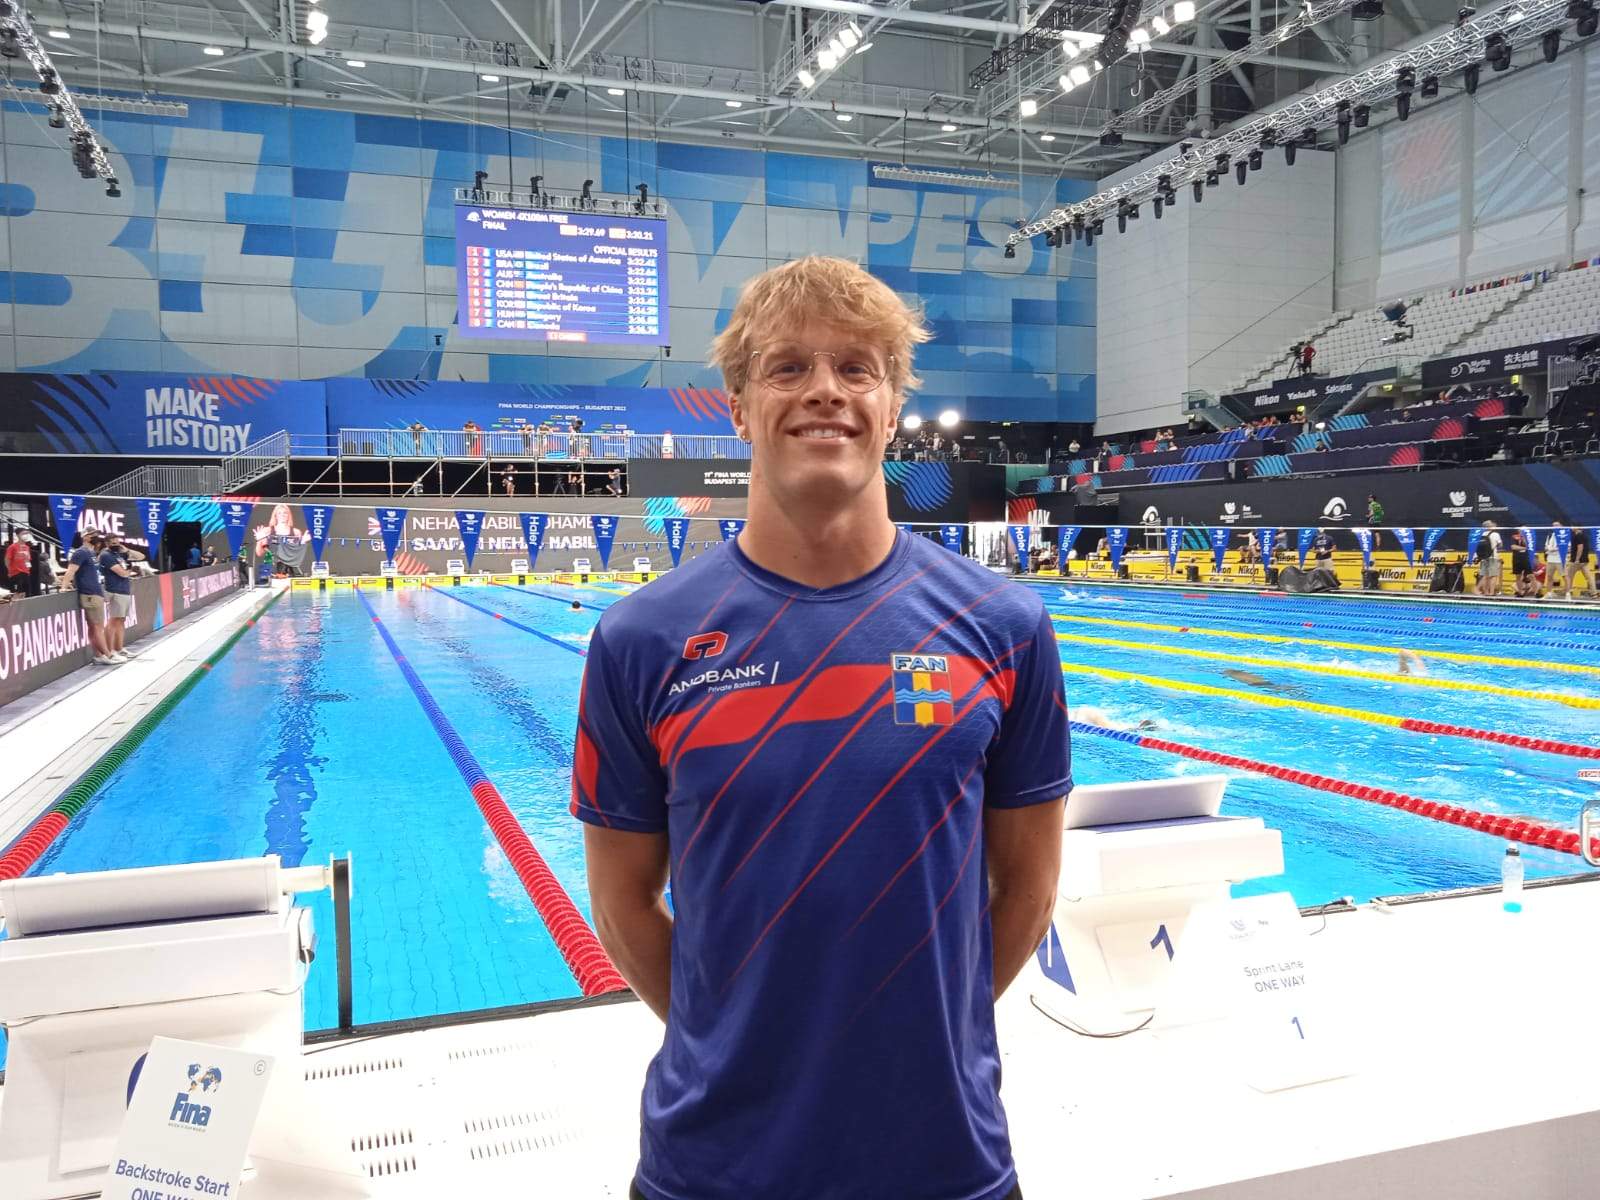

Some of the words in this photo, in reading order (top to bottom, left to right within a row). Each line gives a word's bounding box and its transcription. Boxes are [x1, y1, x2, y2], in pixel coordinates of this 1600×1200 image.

[482, 210, 516, 220] WOMEN
[482, 221, 507, 230] FINAL
[594, 246, 627, 255] OFFICIAL
[628, 248, 657, 257] RESULTS
[145, 387, 220, 421] MAKE
[1254, 394, 1280, 406] Nikon
[146, 418, 251, 452] HISTORY
[78, 509, 125, 536] AKE
[149, 502, 160, 535] Haier
[313, 508, 325, 540] Haier
[412, 517, 460, 530] NEHA
[550, 536, 597, 549] NABIL
[1379, 569, 1406, 579] Nikon
[1416, 569, 1433, 580] Nik
[12, 609, 79, 675] PANIAGUA
[895, 656, 946, 672] FAN
[707, 684, 732, 693] Private
[733, 680, 761, 689] Bankers
[1244, 964, 1277, 978] Sprint
[1279, 960, 1304, 972] Lane
[1254, 979, 1279, 992] ONE
[1281, 975, 1304, 988] WAY
[1291, 1016, 1304, 1040] 1
[169, 1092, 212, 1127] Fina
[115, 1159, 192, 1189] Backstroke
[194, 1175, 230, 1197] Start
